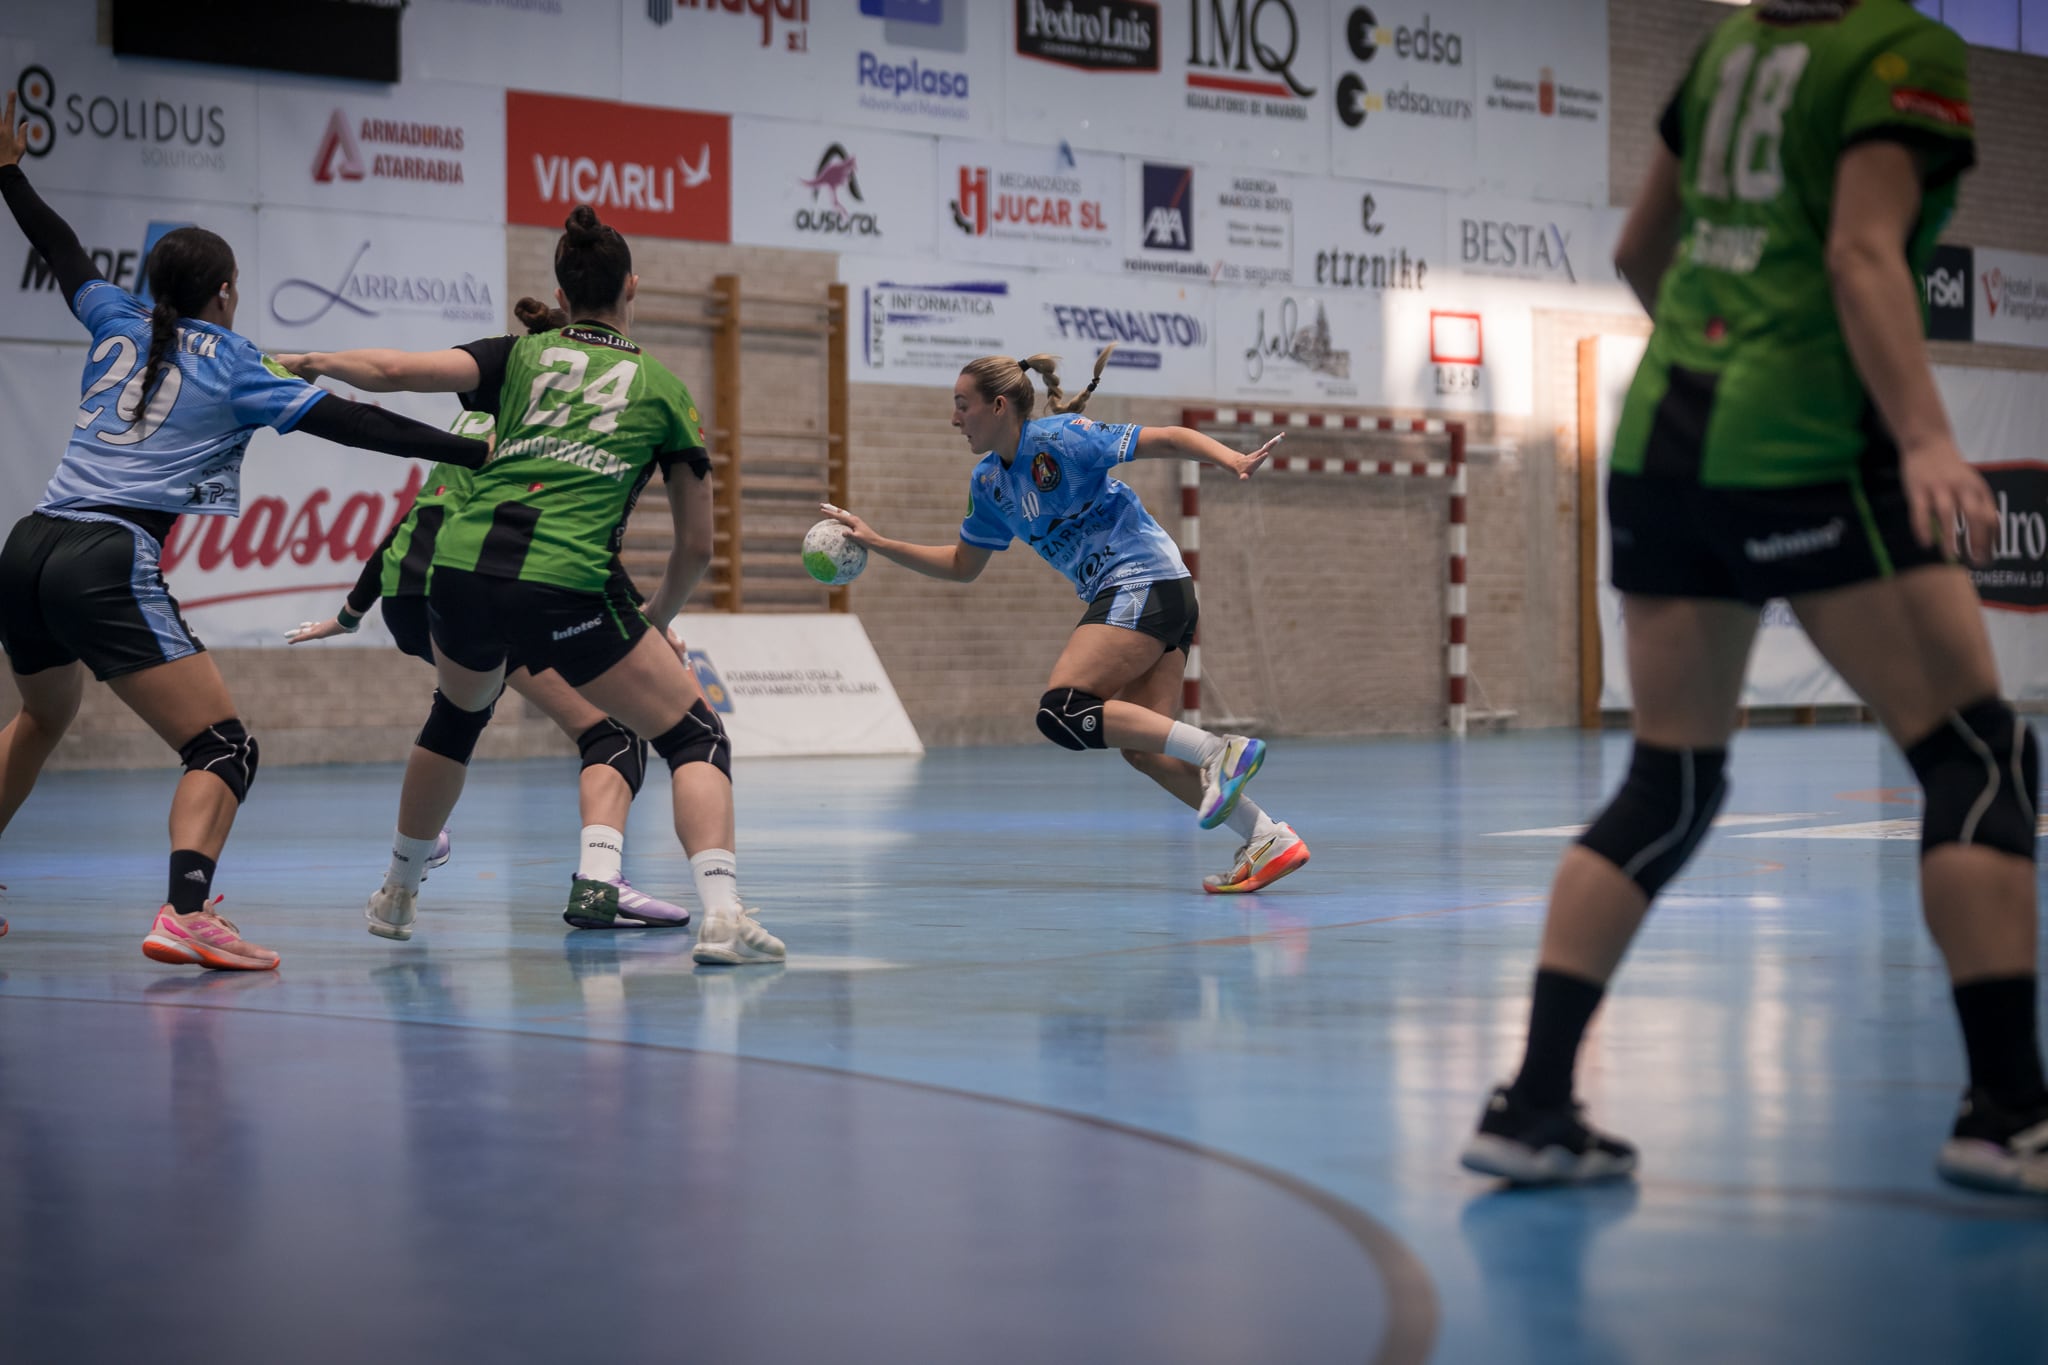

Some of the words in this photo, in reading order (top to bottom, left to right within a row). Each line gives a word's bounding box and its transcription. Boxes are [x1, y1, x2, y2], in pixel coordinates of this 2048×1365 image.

[1187, 0, 1317, 98] IMQ
[1395, 14, 1462, 66] edsa
[858, 51, 969, 98] Replasa
[66, 93, 225, 147] SOLIDUS
[360, 117, 465, 151] ARMADURAS
[1699, 42, 1810, 199] 18
[141, 148, 226, 170] SOLUTIONS
[373, 153, 464, 184] ATARRABIA
[534, 153, 675, 213] VICARLI
[998, 173, 1082, 194] MECANIZADOS
[795, 208, 883, 236] austral
[993, 193, 1072, 227] JUCAR
[1080, 201, 1107, 231] SL
[1143, 206, 1188, 246] AXA
[1125, 257, 1211, 277] reinventando
[1461, 218, 1577, 284] BESTAX
[891, 294, 995, 314] INFORMATICA
[1054, 304, 1194, 347] FRENAUTO
[84, 335, 183, 445] 29
[522, 347, 638, 435] 24
[1021, 490, 1040, 522] 40
[552, 616, 602, 641] Infotec
[733, 683, 816, 697] AYUNTAMIENTO
[819, 683, 832, 694] DE
[837, 681, 881, 695] VILLAVA
[806, 669, 843, 681] UDALA
